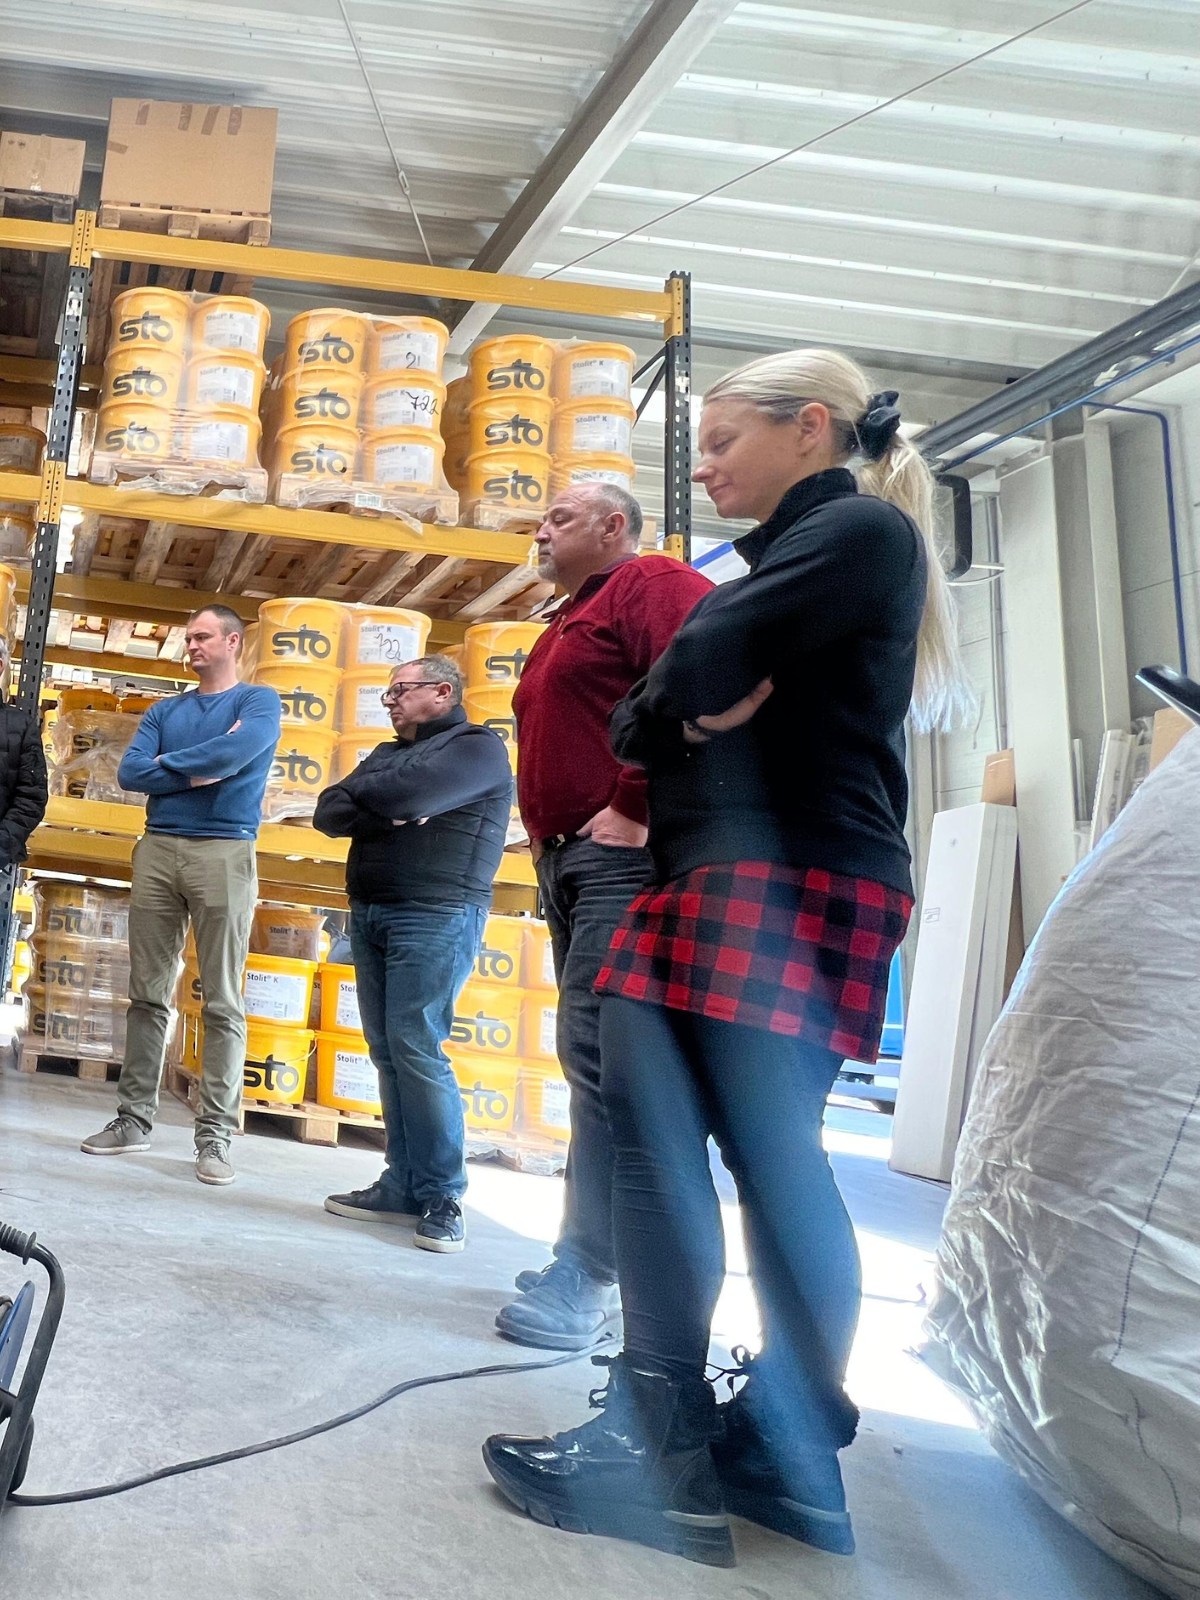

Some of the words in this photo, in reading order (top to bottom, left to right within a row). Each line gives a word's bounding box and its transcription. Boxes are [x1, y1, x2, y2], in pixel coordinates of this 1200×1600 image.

[119, 311, 174, 343] sto
[298, 332, 354, 364] sto
[112, 366, 167, 397] sto
[487, 358, 545, 391] sto
[294, 387, 351, 420] sto
[104, 422, 160, 453] sto
[485, 414, 543, 446] sto
[290, 443, 348, 476] sto
[483, 469, 542, 503] sto
[272, 623, 331, 659] sto
[485, 648, 530, 680] st
[39, 955, 87, 989] sto
[471, 942, 513, 979] to
[340, 983, 356, 993] Stol
[450, 1011, 512, 1049] sto
[243, 1054, 299, 1092] sto
